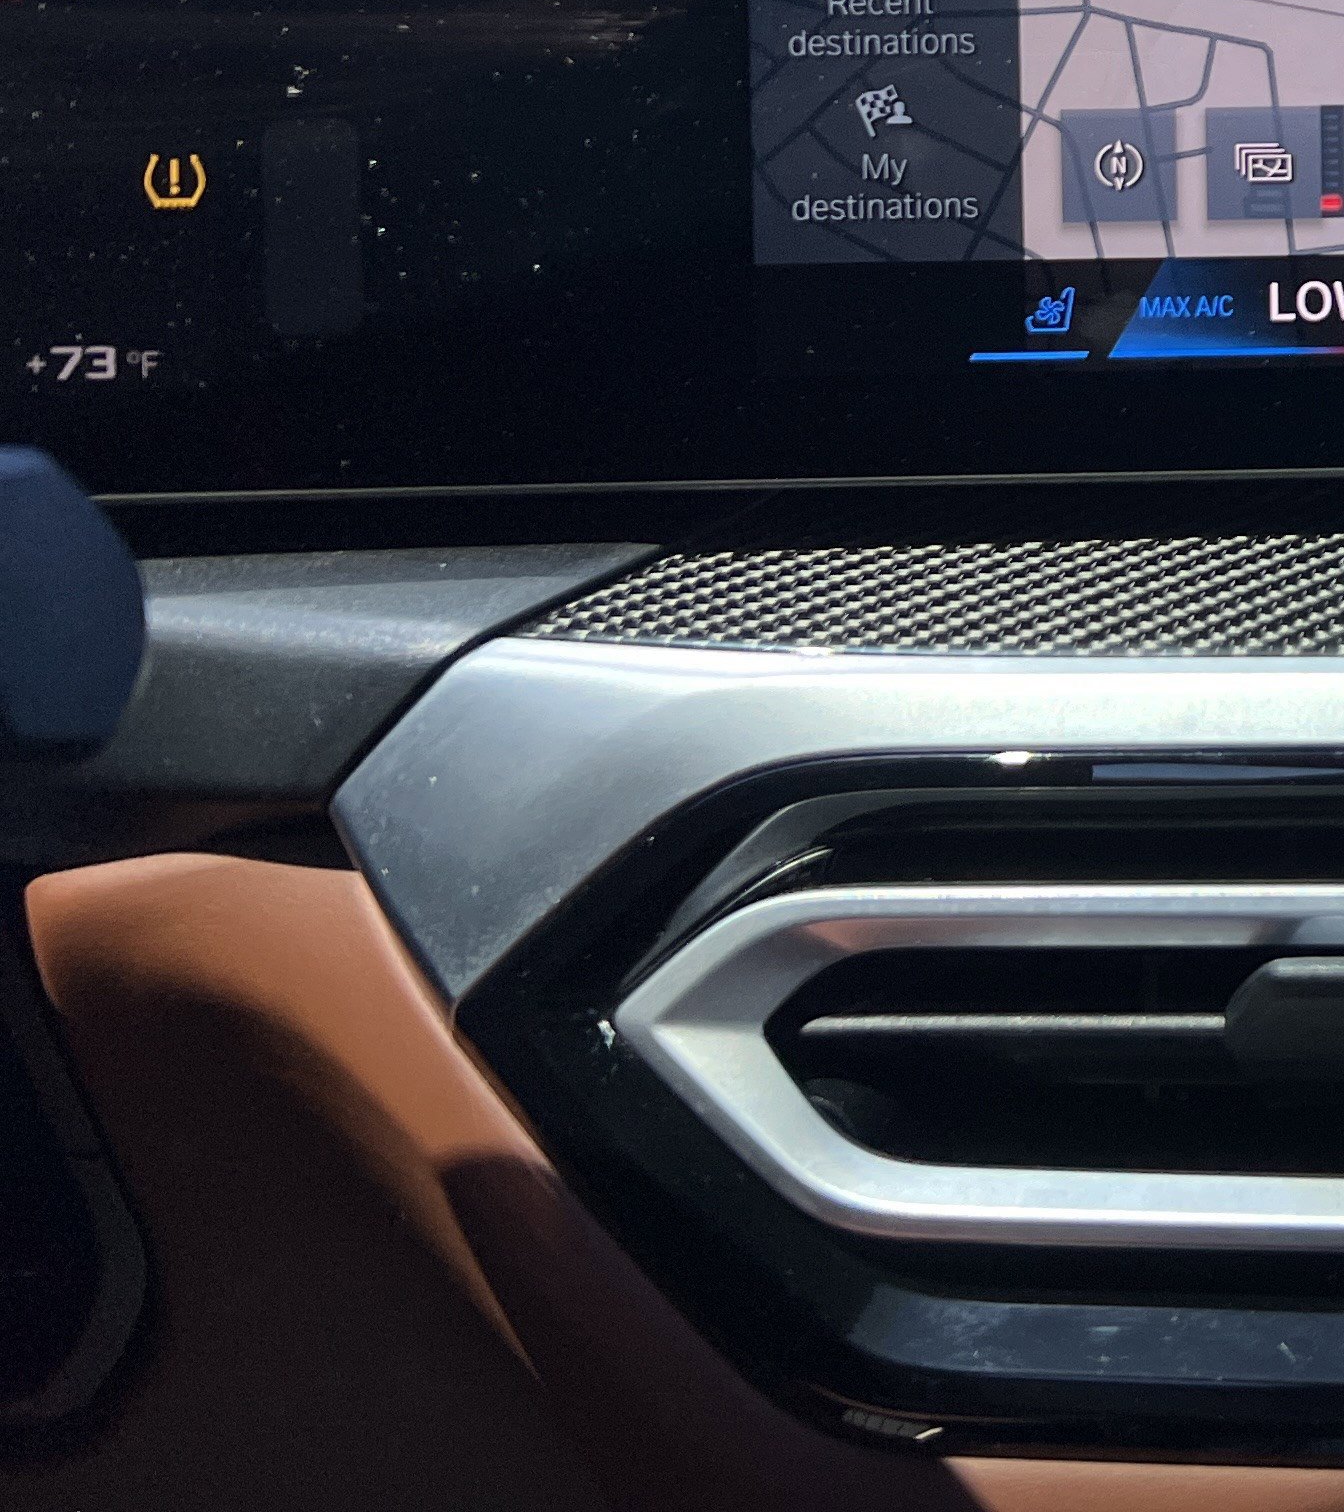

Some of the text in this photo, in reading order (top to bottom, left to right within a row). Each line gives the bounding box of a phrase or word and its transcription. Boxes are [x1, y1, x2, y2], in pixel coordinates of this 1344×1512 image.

[788, 29, 975, 57] destinations
[862, 153, 908, 186] My
[1110, 156, 1127, 174] N
[791, 194, 979, 221] destinations
[1139, 294, 1234, 319] MAX A/C
